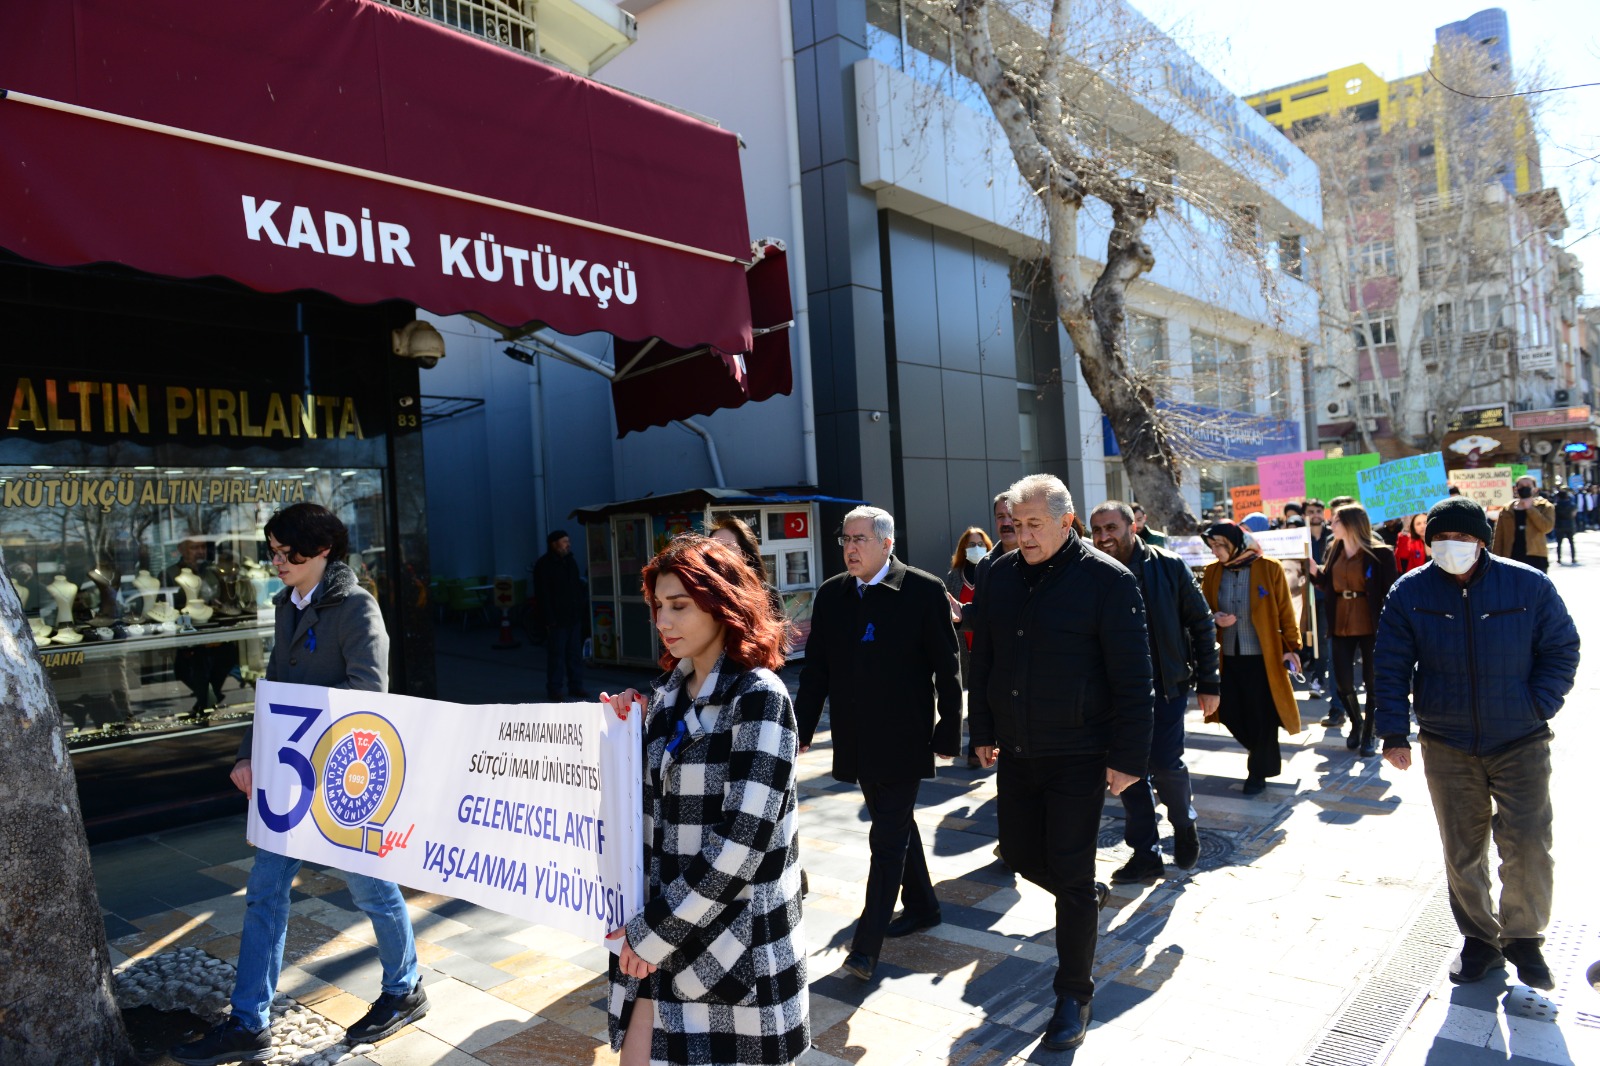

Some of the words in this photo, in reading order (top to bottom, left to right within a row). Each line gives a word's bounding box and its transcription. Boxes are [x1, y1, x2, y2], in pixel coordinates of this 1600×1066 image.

[241, 195, 415, 268] KADİR
[439, 231, 638, 309] KÜTÜKÇÜ
[7, 377, 150, 434] ALTIN
[166, 386, 364, 440] PIRLANTA
[397, 414, 417, 427] 83
[3, 472, 135, 513] KÜTÜKÇÜ
[139, 479, 203, 506] ALTIN
[208, 479, 305, 505] PIRLANTA
[498, 722, 583, 752] KAHRAMANMARAŞ
[348, 774, 365, 785] 1992
[469, 750, 508, 780] SÜTÇÜ
[508, 753, 539, 781] İMAM
[541, 755, 602, 792] ÜNİVERSİTESİ
[378, 823, 415, 858] yıl
[457, 794, 562, 848] GELENEKSEL
[563, 809, 606, 855] AKTİF
[423, 840, 527, 896] YAŞLANMA
[534, 861, 625, 930] YÜRÜYÜŞÜ
